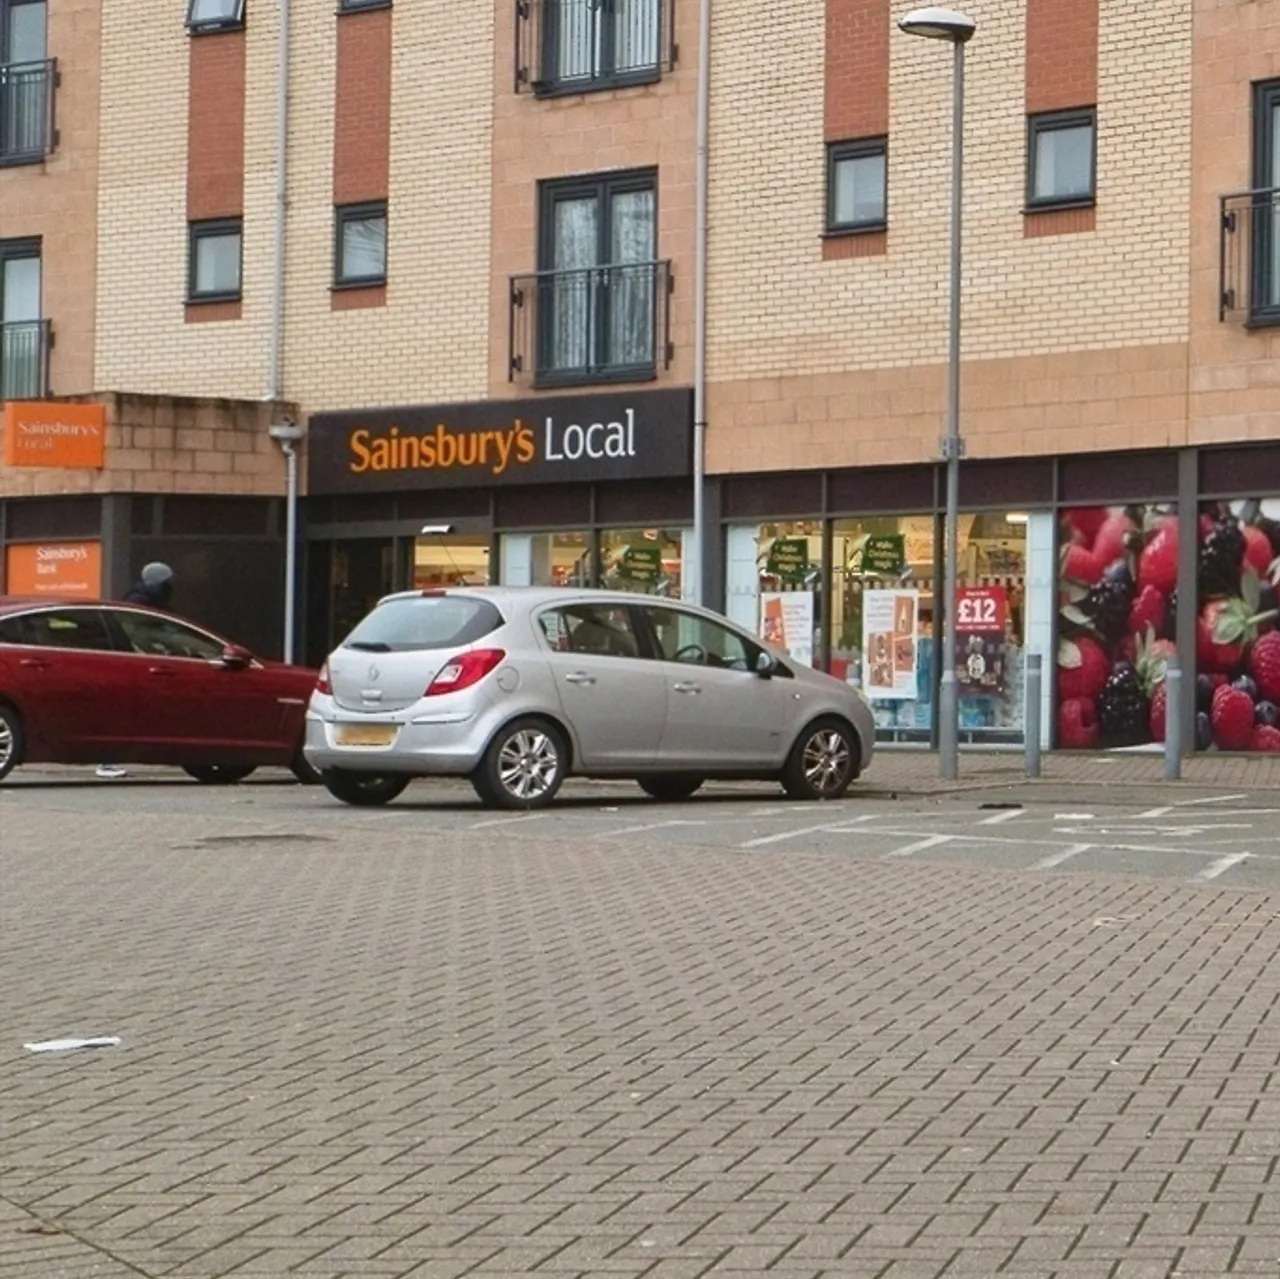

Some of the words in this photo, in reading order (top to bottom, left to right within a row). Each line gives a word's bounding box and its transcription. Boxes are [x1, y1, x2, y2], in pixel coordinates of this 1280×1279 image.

[17, 420, 99, 437] Sainsbury's
[350, 419, 535, 474] Sainsbury's
[545, 408, 636, 460] Local
[957, 598, 997, 623] £12
